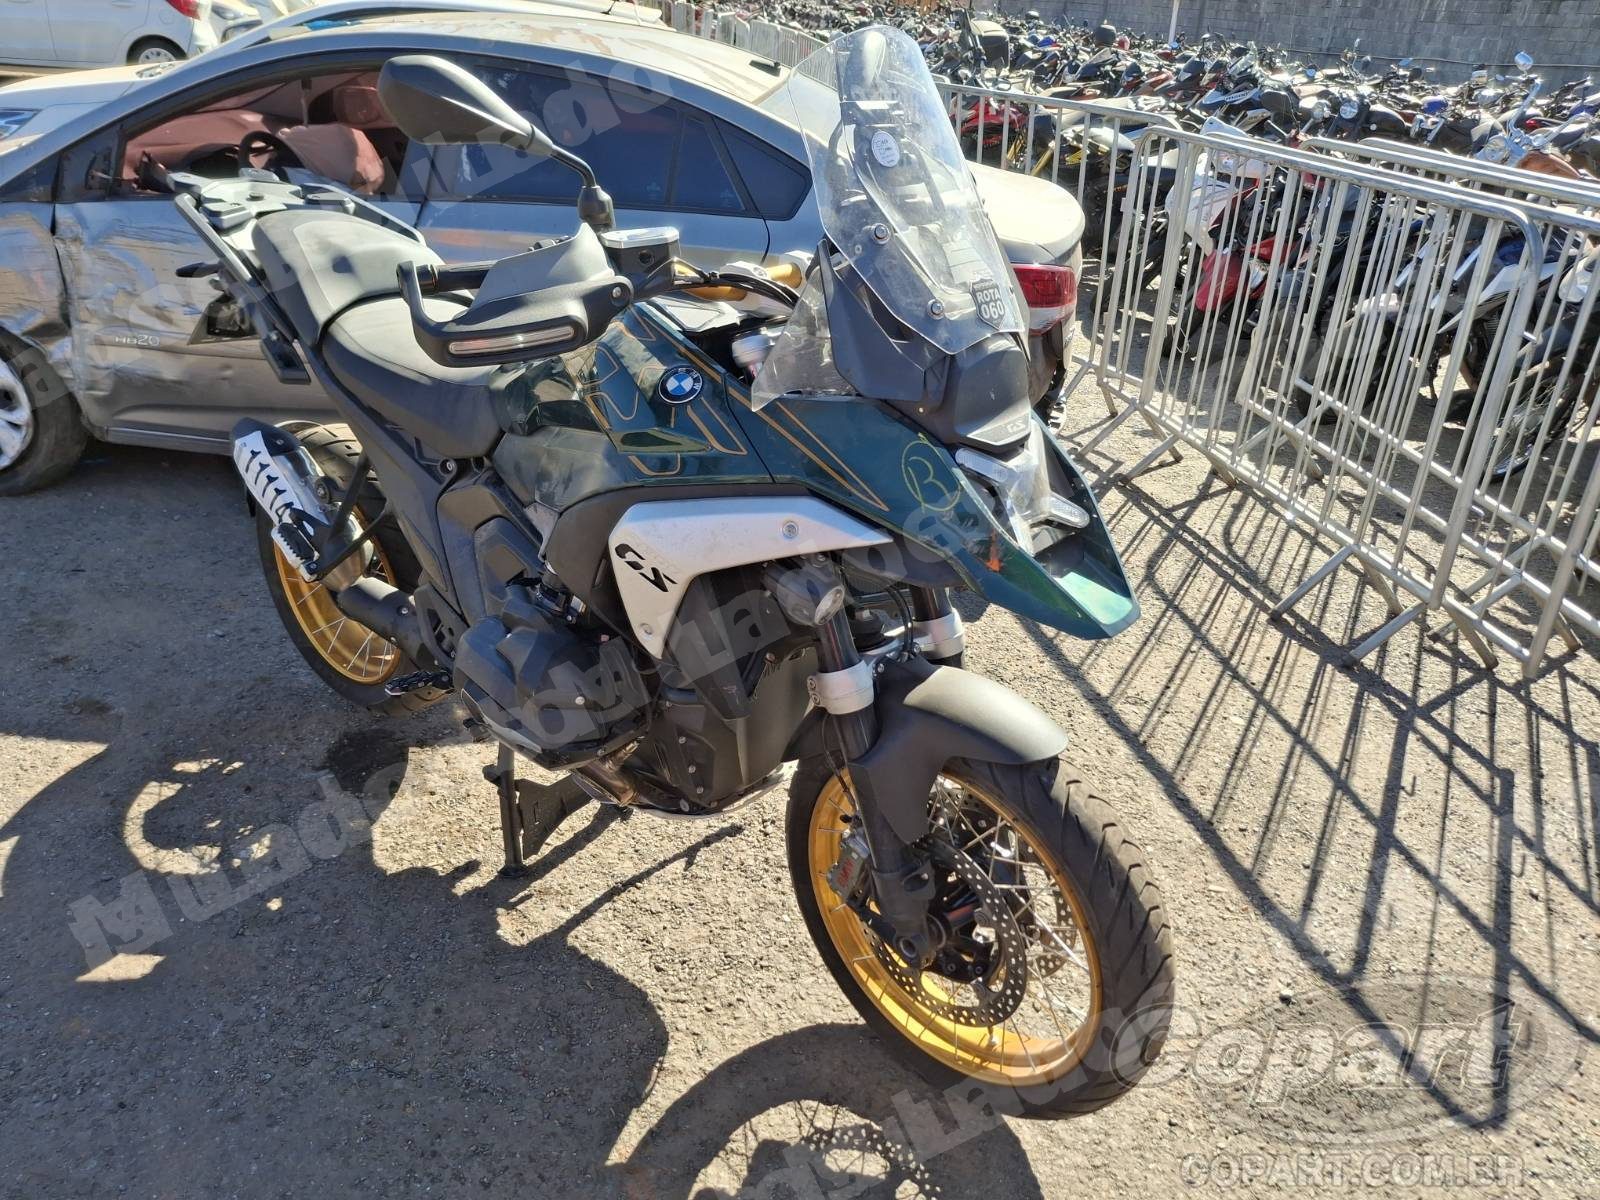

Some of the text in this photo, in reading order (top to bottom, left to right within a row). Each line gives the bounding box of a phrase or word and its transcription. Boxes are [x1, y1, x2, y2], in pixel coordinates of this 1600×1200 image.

[975, 287, 1001, 303] ROTA
[980, 300, 1005, 319] 060
[114, 334, 160, 347] HB20
[614, 543, 678, 592] GS
